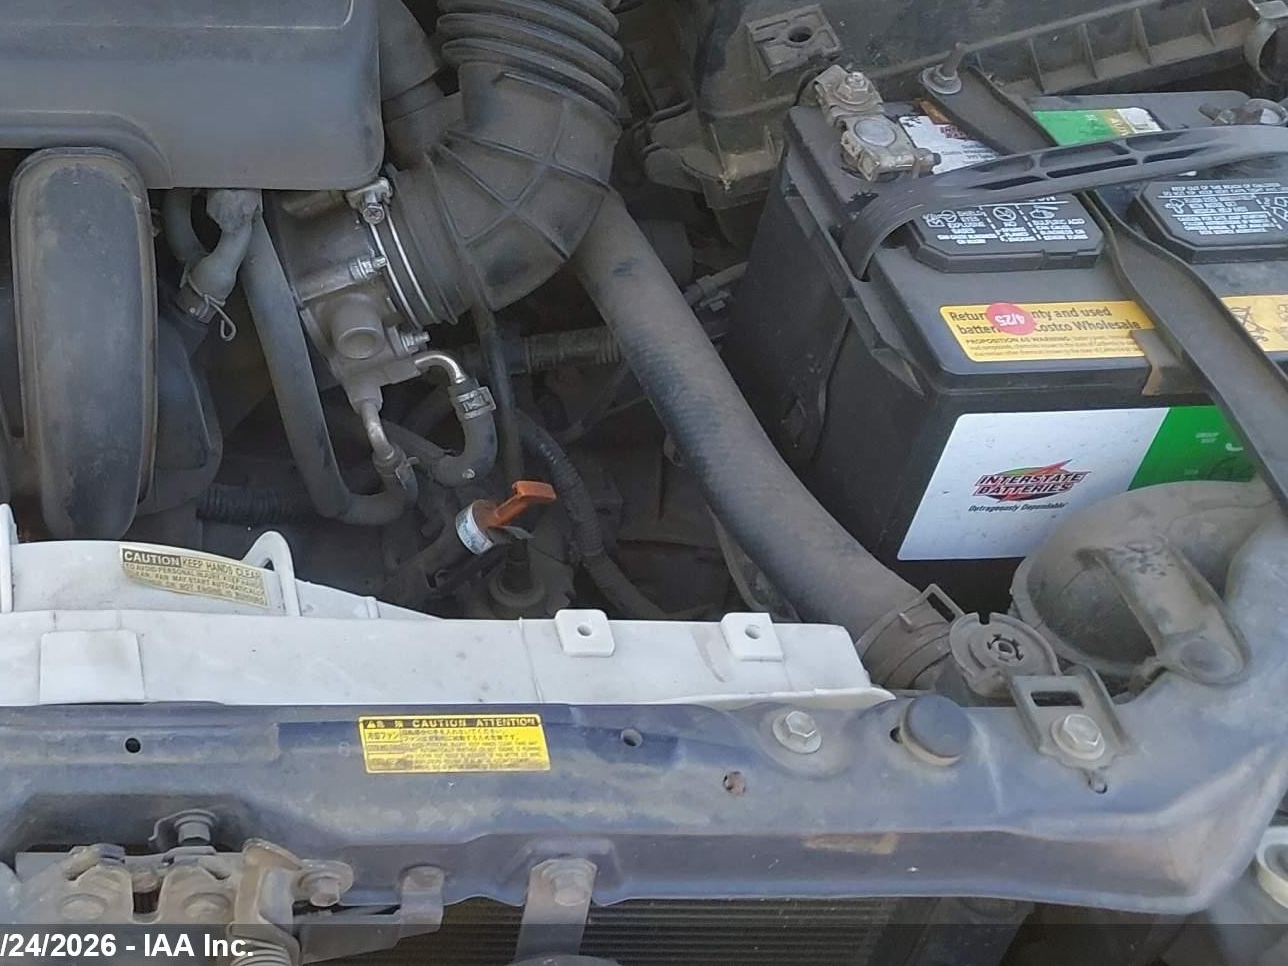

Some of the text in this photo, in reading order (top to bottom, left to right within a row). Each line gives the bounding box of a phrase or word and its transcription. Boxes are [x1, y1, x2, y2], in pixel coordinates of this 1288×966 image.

[1054, 307, 1079, 319] and
[1080, 306, 1112, 317] used
[995, 314, 1025, 326] 4/25
[1073, 319, 1142, 331] Wholesale
[977, 472, 1085, 485] INTERSTATE
[975, 483, 1073, 495] BATTERIES
[124, 551, 180, 567] CAUTION
[206, 560, 233, 575] HANDS
[412, 717, 537, 728] CAUTION ATTENTION
